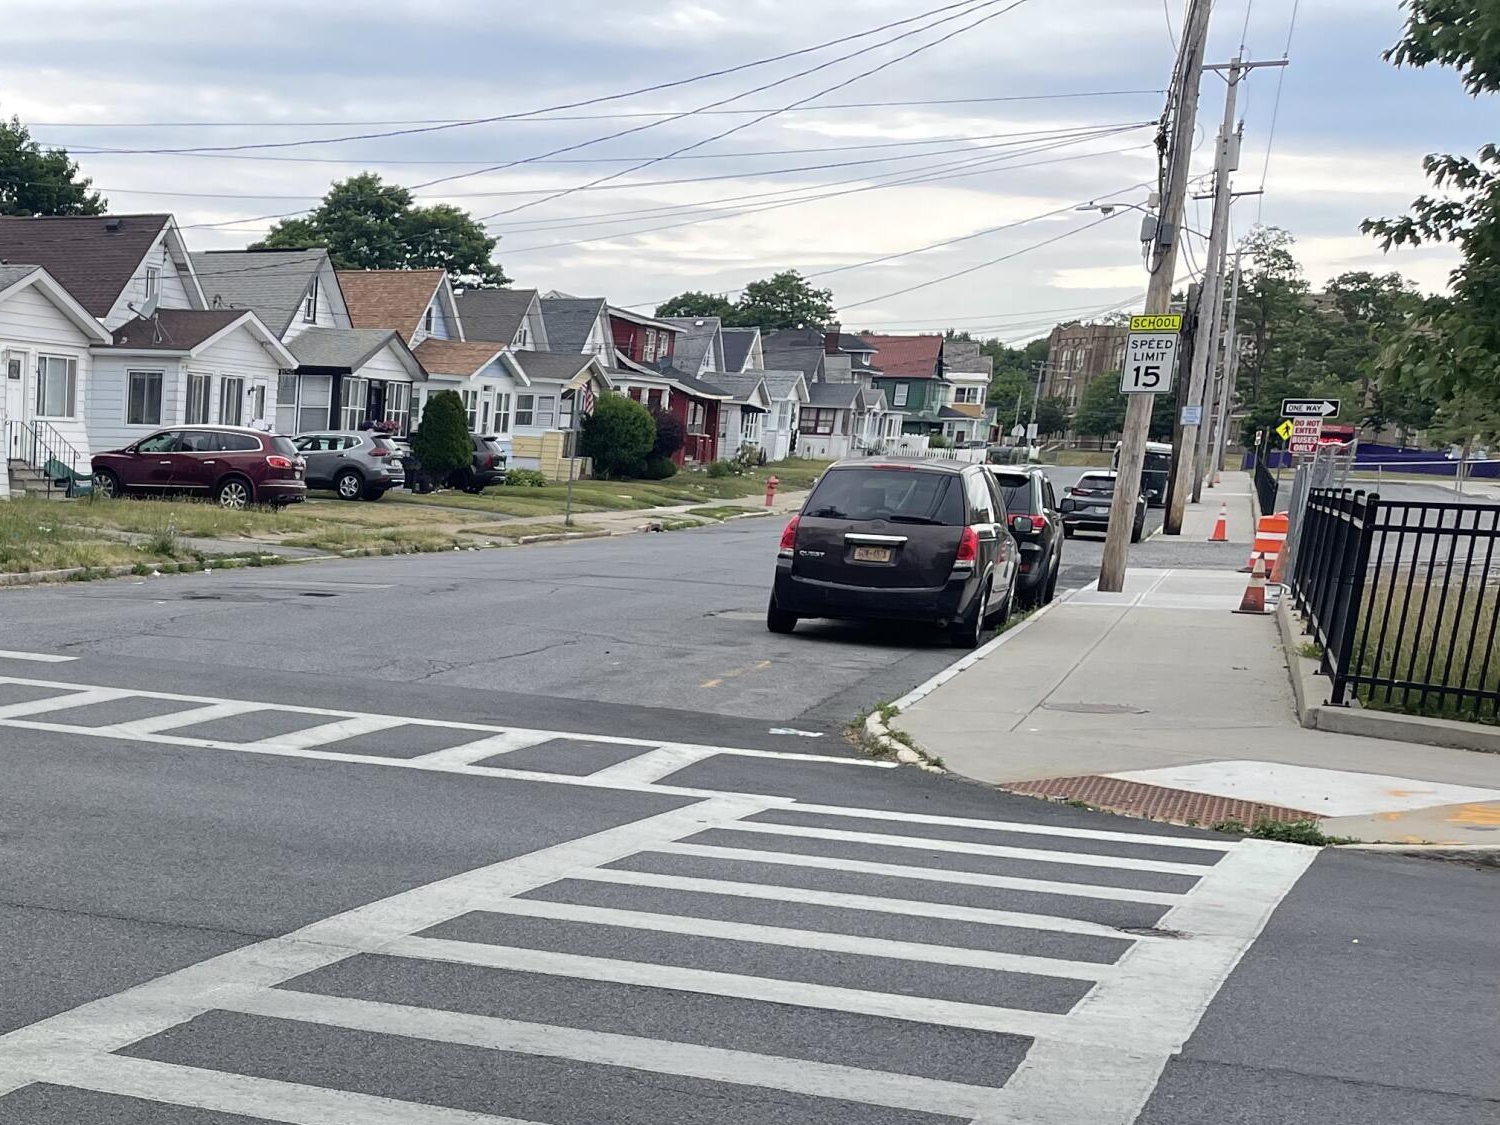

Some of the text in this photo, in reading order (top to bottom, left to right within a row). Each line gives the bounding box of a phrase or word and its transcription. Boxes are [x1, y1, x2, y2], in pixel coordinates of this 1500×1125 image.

[1133, 318, 1178, 328] SCHOOL
[1131, 339, 1173, 349] SPEED
[1133, 352, 1167, 362] LIMIT
[1133, 365, 1161, 388] 15
[1288, 404, 1304, 412] ONE
[1291, 436, 1318, 444] BUSES
[1293, 444, 1314, 452] ONLY
